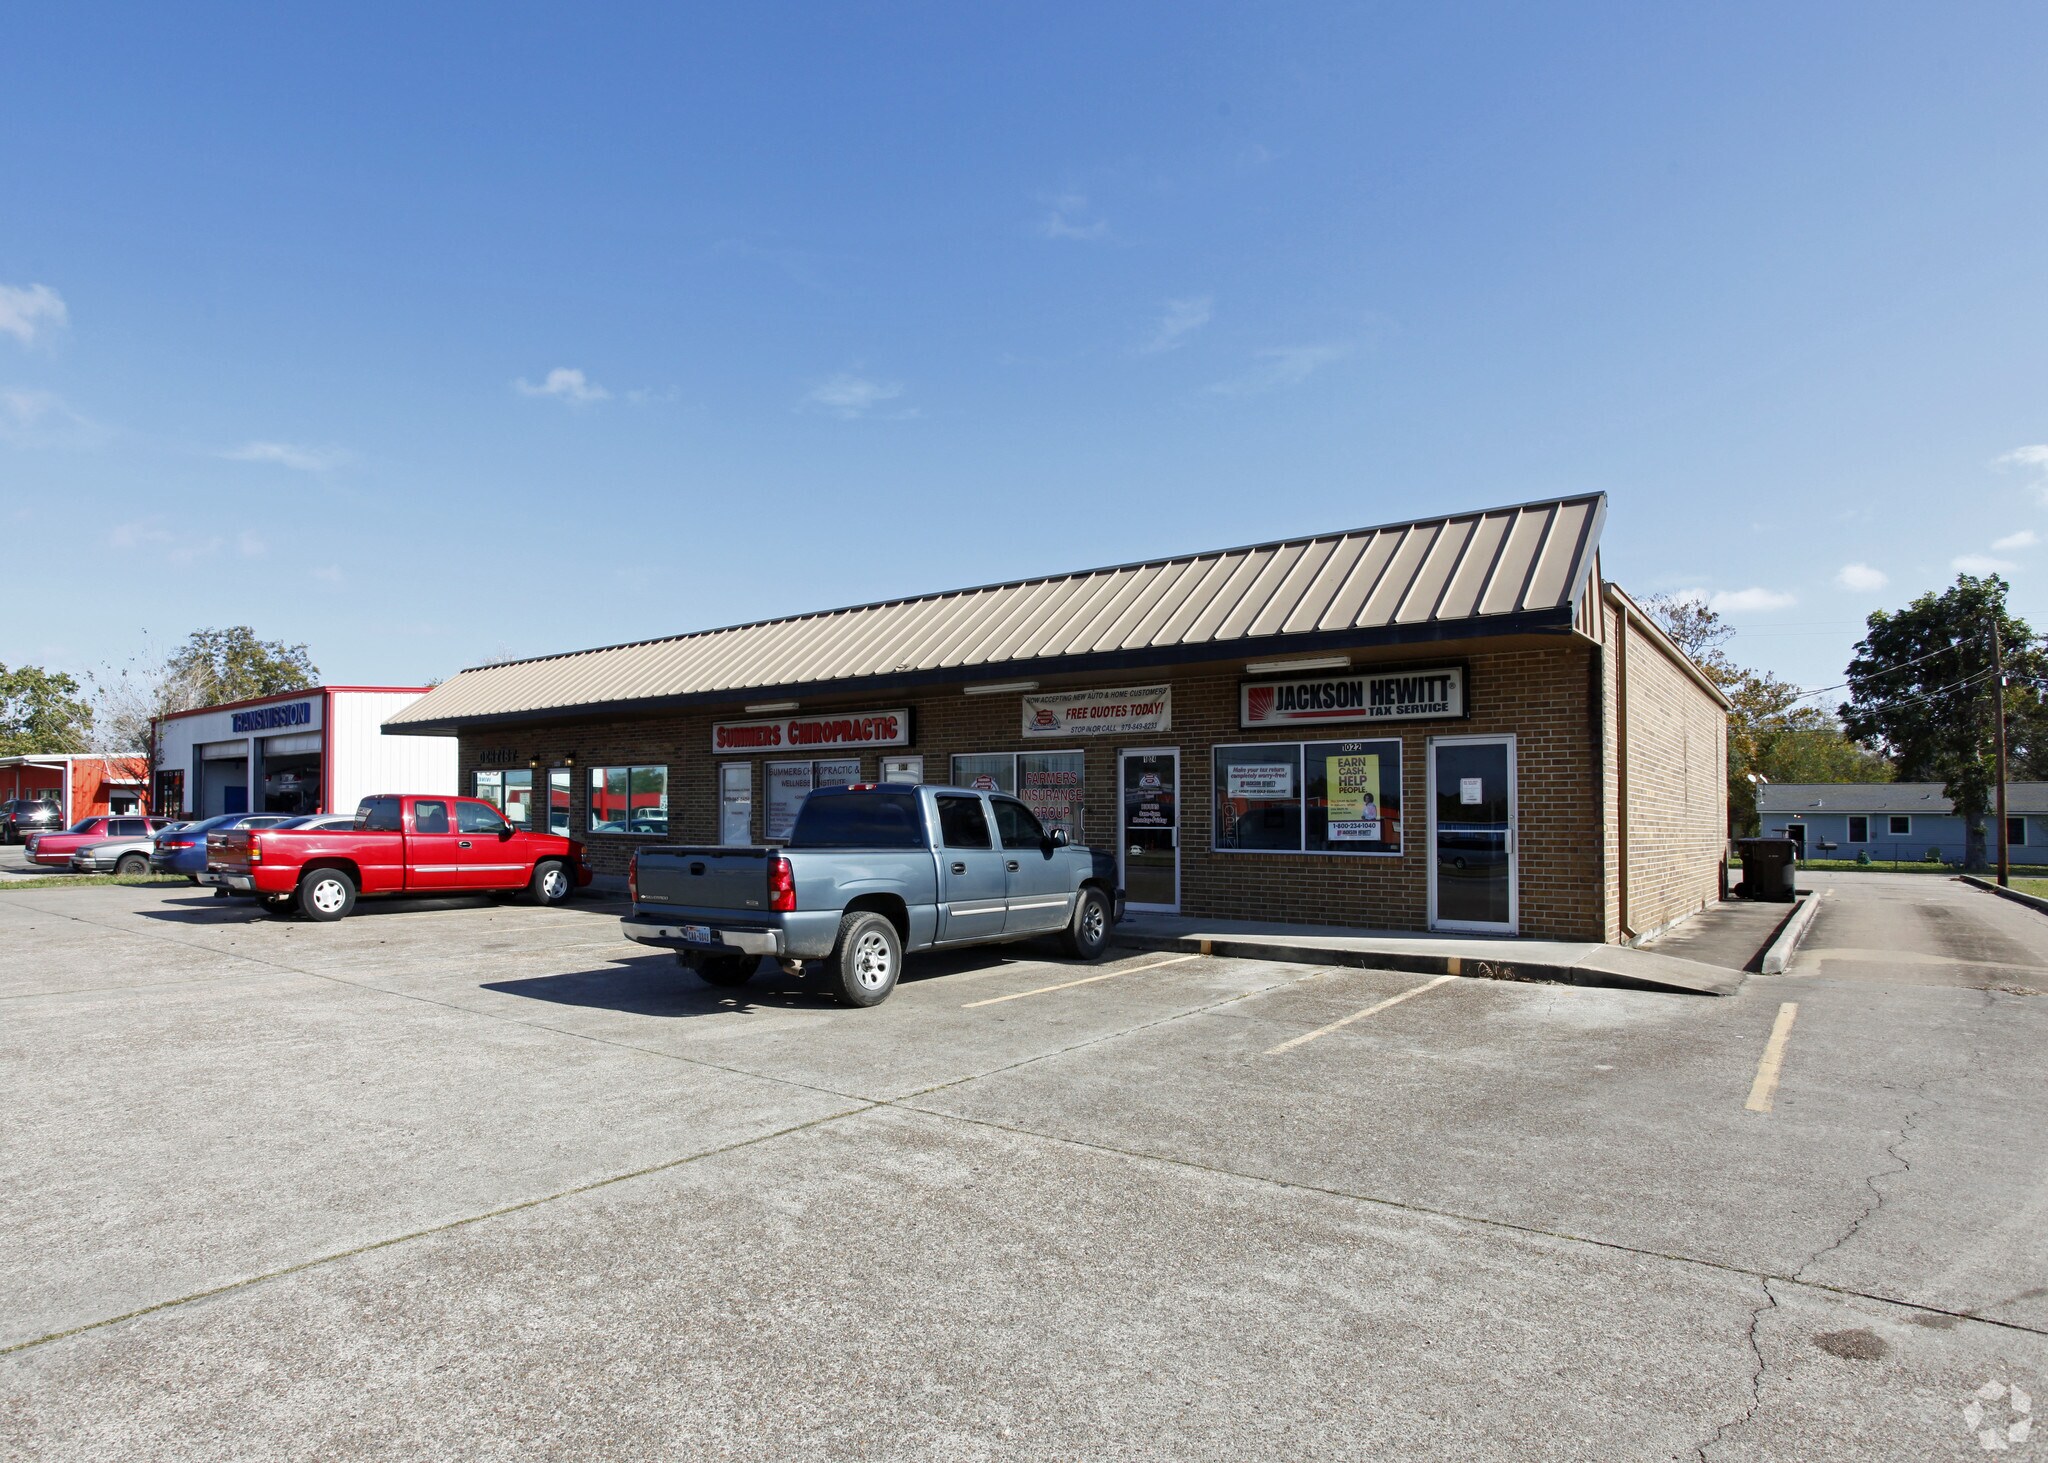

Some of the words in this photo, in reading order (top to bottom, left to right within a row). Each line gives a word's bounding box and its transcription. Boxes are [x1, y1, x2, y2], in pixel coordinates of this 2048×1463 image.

[1040, 695, 1072, 704] ACCEPTING
[1073, 693, 1086, 701] NEW
[1087, 691, 1103, 700] AUTO
[1110, 690, 1128, 698] HOME
[1129, 687, 1168, 697] CUSTOMERS
[1276, 681, 1363, 711] JACKSON
[1370, 674, 1451, 706] HEWITT
[1066, 707, 1088, 720] FREE
[1090, 704, 1128, 719] QUOTES
[1130, 702, 1164, 716] TODAY!
[1368, 706, 1391, 717] TAX
[1396, 702, 1449, 715] SERVICE
[230, 702, 310, 732] TRANSMISSION
[1101, 724, 1117, 732] CALL
[1342, 743, 1361, 751] 1022
[1338, 757, 1366, 767] EARN
[769, 767, 802, 776] SUMMERS
[854, 765, 860, 774] &
[1338, 768, 1367, 776] CASH.
[1026, 772, 1077, 785] FARMERS
[1339, 776, 1367, 787] HELP
[1021, 789, 1083, 802] INSURANCE
[1032, 806, 1070, 819] GROUP
